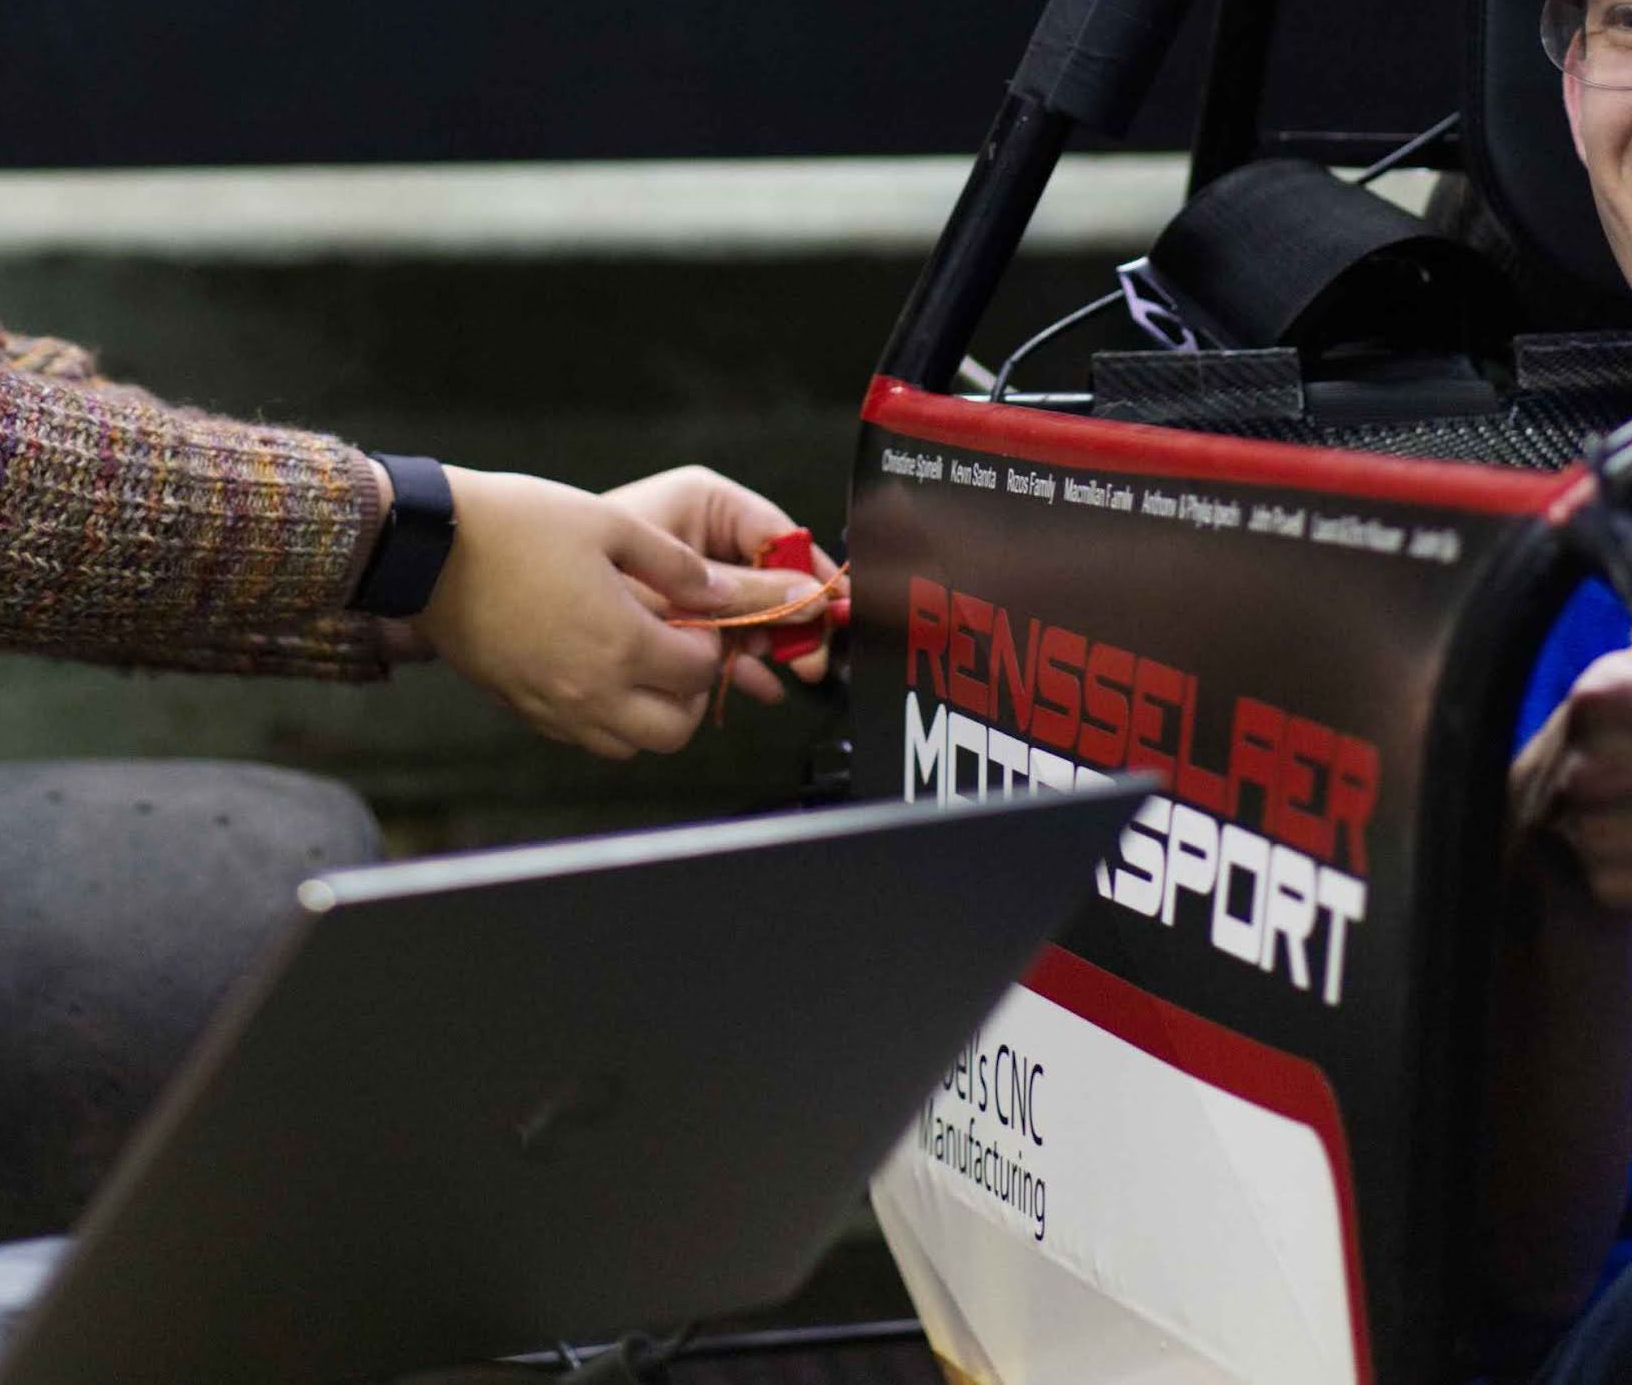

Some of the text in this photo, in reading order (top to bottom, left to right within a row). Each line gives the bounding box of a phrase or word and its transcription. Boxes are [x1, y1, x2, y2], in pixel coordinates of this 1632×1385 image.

[1029, 471, 1057, 505] Family
[1105, 482, 1134, 512] Family
[906, 576, 1380, 879] RENSSELAER
[903, 689, 1367, 1007] MOTSPORT
[995, 1044, 1045, 1147] CNC
[919, 1097, 1046, 1242] Manufacturing
